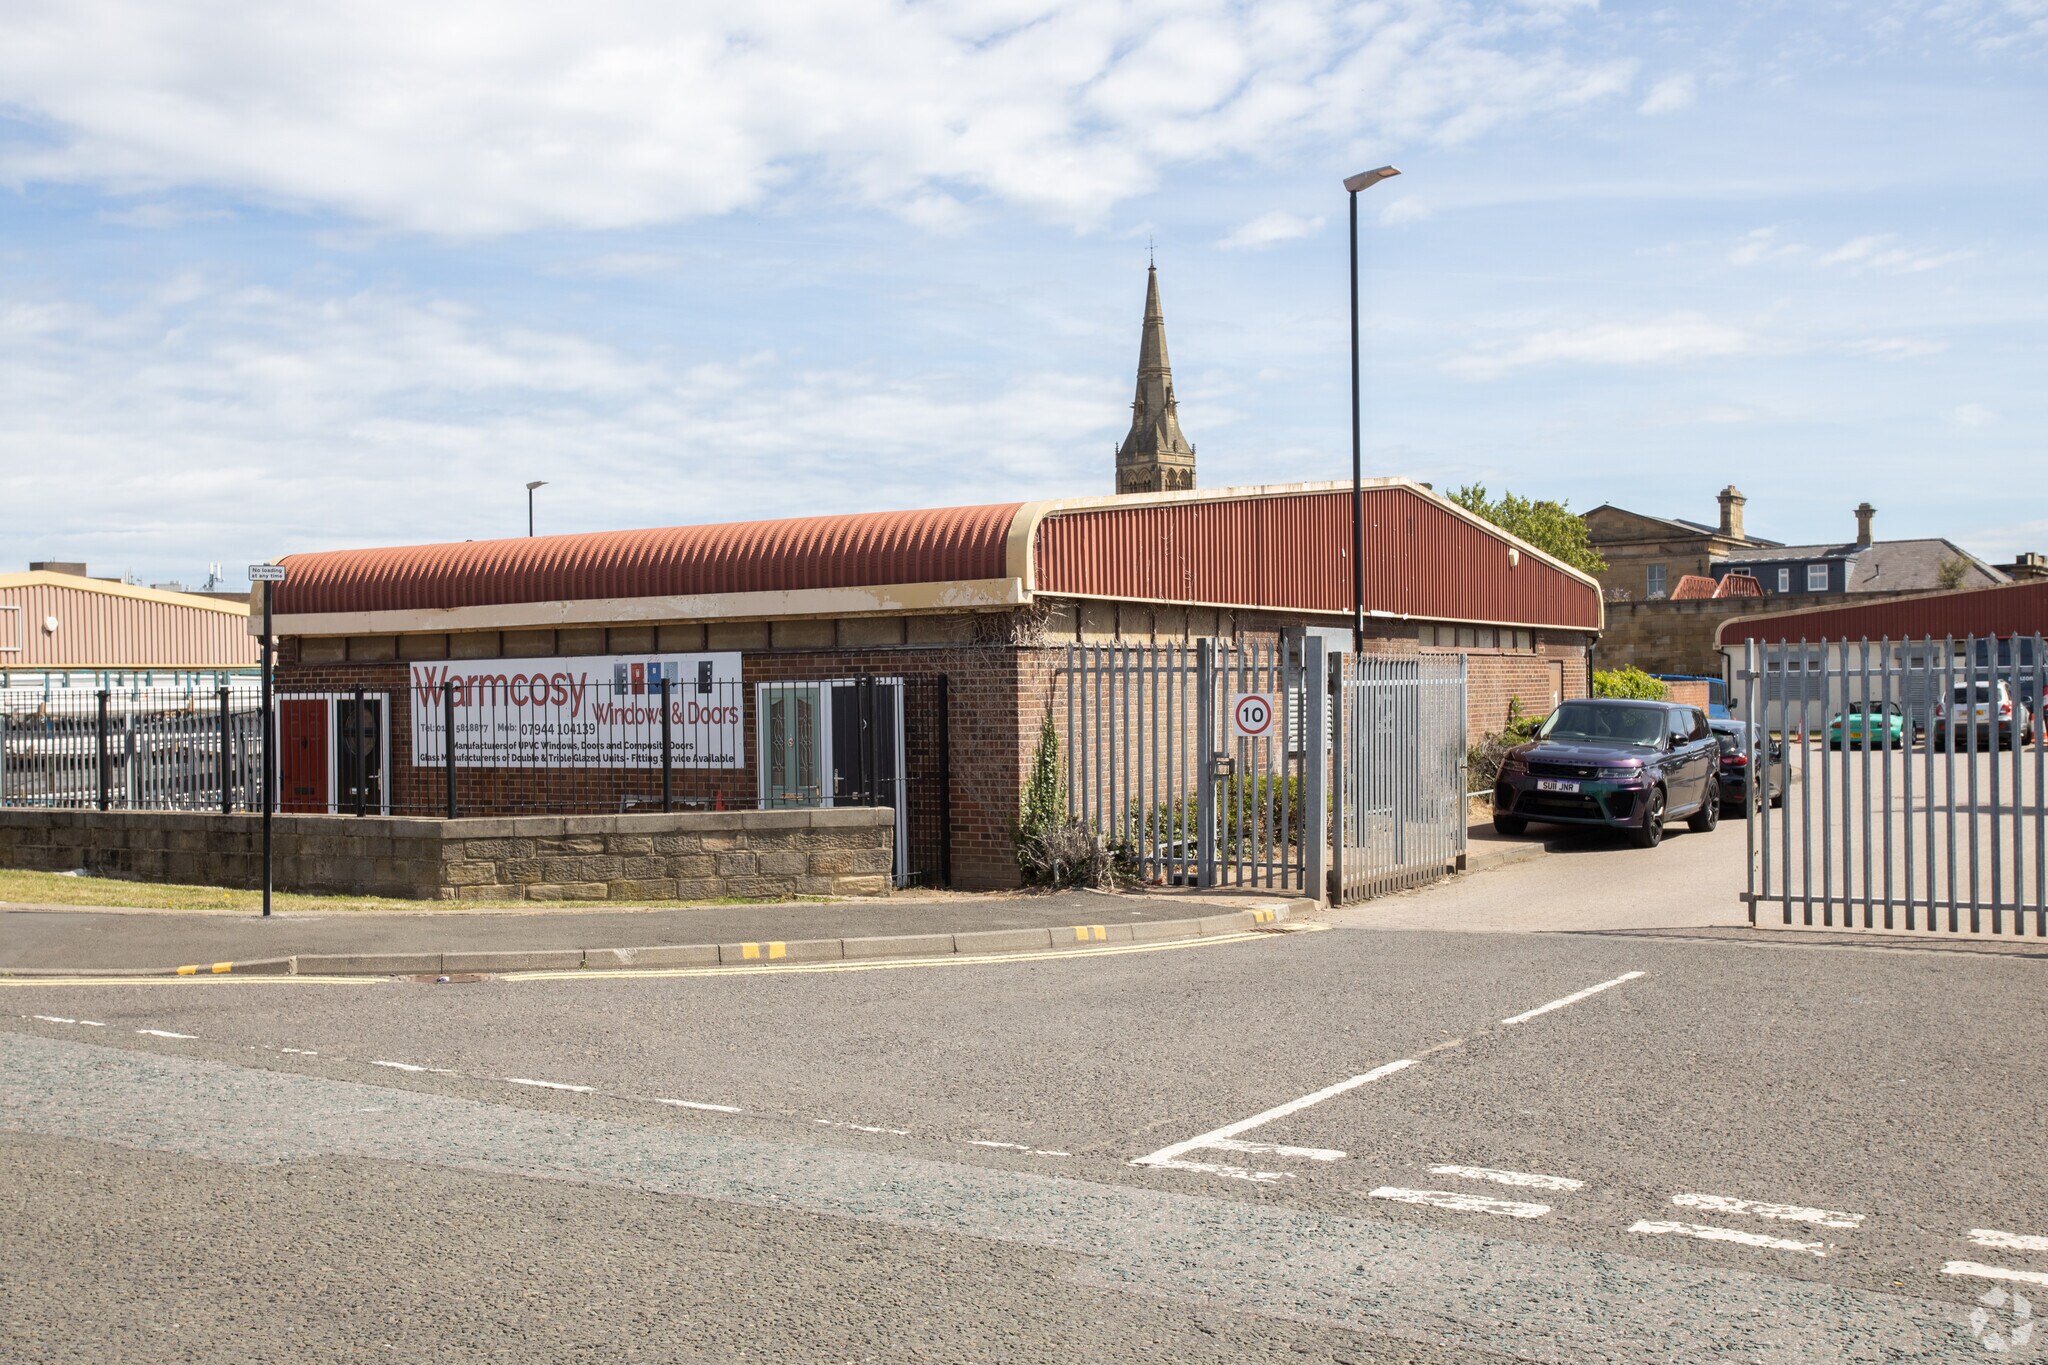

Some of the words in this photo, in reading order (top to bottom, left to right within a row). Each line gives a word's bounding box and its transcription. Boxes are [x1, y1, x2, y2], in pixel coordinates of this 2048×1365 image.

[413, 665, 587, 718] Warmcosy
[592, 702, 664, 725] Windows
[671, 701, 683, 725] &
[688, 701, 738, 725] Doors
[1243, 707, 1264, 723] 10
[420, 723, 435, 732] Tel:
[456, 723, 488, 733] 5818877
[497, 723, 517, 731] Mob:
[521, 723, 554, 735] 07944
[557, 723, 596, 735] 104139
[509, 741, 517, 749] of
[518, 741, 539, 750] UPVC
[540, 741, 579, 751] Windows,
[581, 741, 604, 750] Doors
[606, 741, 622, 750] and
[624, 741, 664, 751] Composit
[670, 741, 694, 750] Doors
[420, 753, 440, 762] Glass
[502, 753, 510, 762] of
[511, 753, 539, 762] Double
[541, 753, 547, 762] &
[548, 753, 572, 763] Triple
[573, 753, 601, 762] Glazed
[603, 753, 625, 762] Units
[631, 753, 659, 764] Fitting
[660, 753, 691, 762] Srvice
[693, 753, 735, 763] Available
[1559, 783, 1574, 791] JNR
